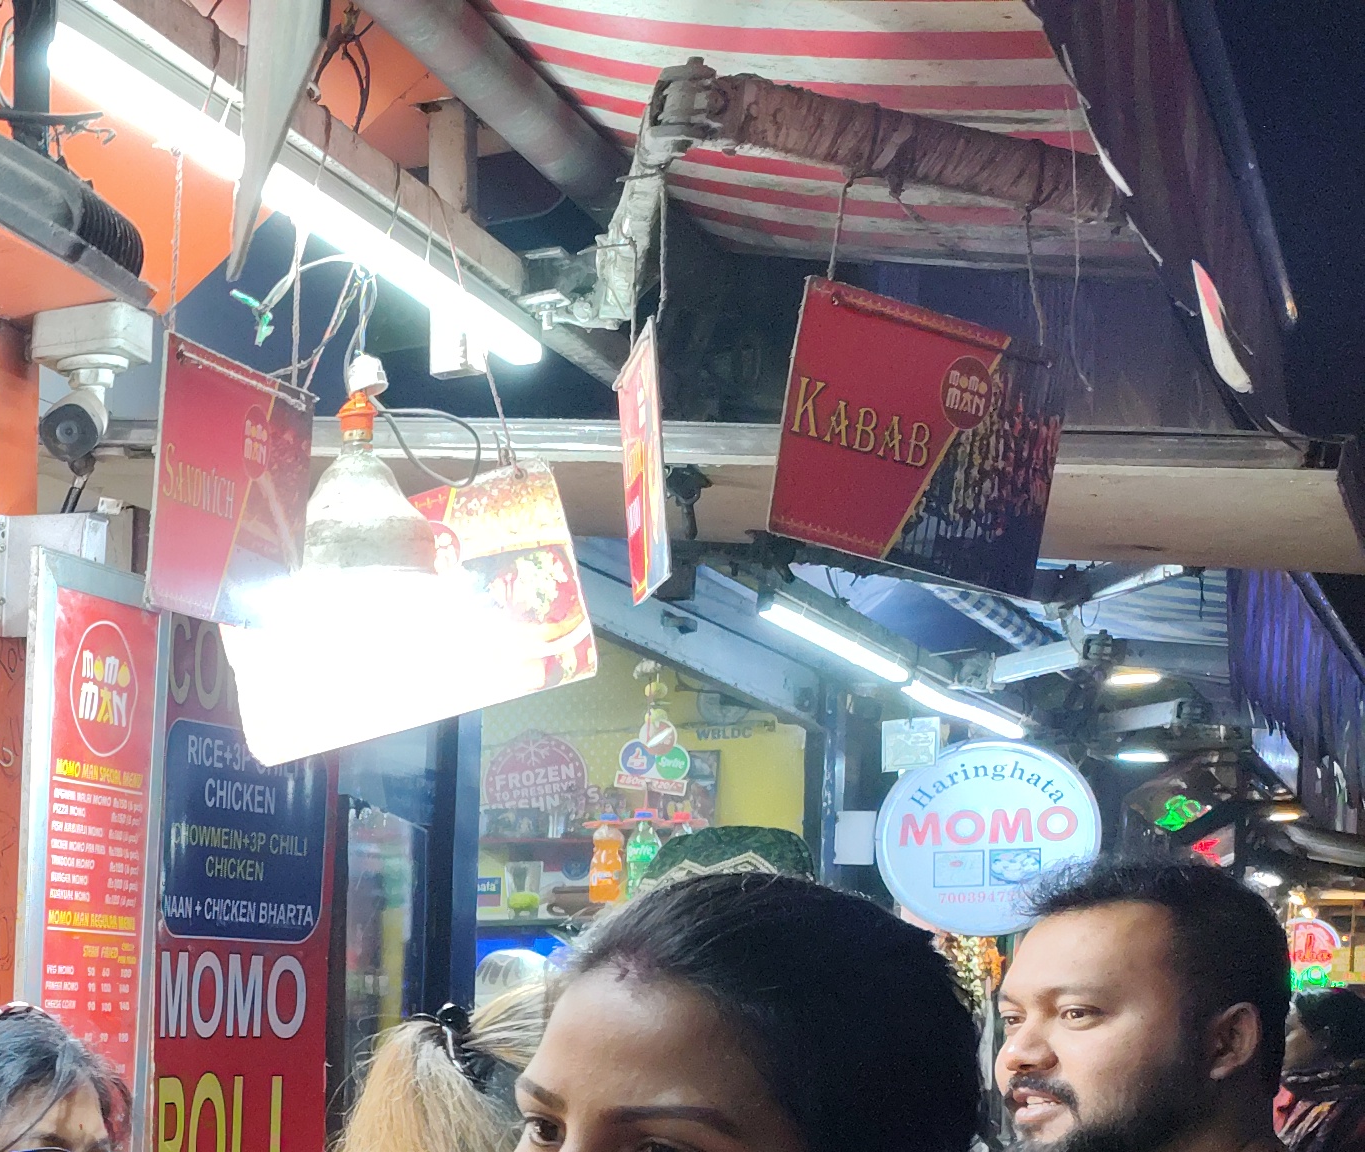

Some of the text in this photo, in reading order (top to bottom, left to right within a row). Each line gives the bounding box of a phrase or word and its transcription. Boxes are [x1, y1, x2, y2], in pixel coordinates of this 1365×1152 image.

[790, 376, 932, 468] KABAB
[494, 763, 576, 792] FROZEN
[910, 761, 1065, 810] Haringhata
[204, 777, 276, 815] CHICKEN
[495, 791, 510, 802] TO
[899, 806, 1079, 847] MOMO
[205, 856, 265, 882] CHICKEN
[48, 909, 72, 926] MOMO
[164, 895, 193, 919] NAAN
[204, 897, 257, 924] CHICKEN
[258, 902, 315, 928] BHARTA
[159, 950, 307, 1039] MOMO
